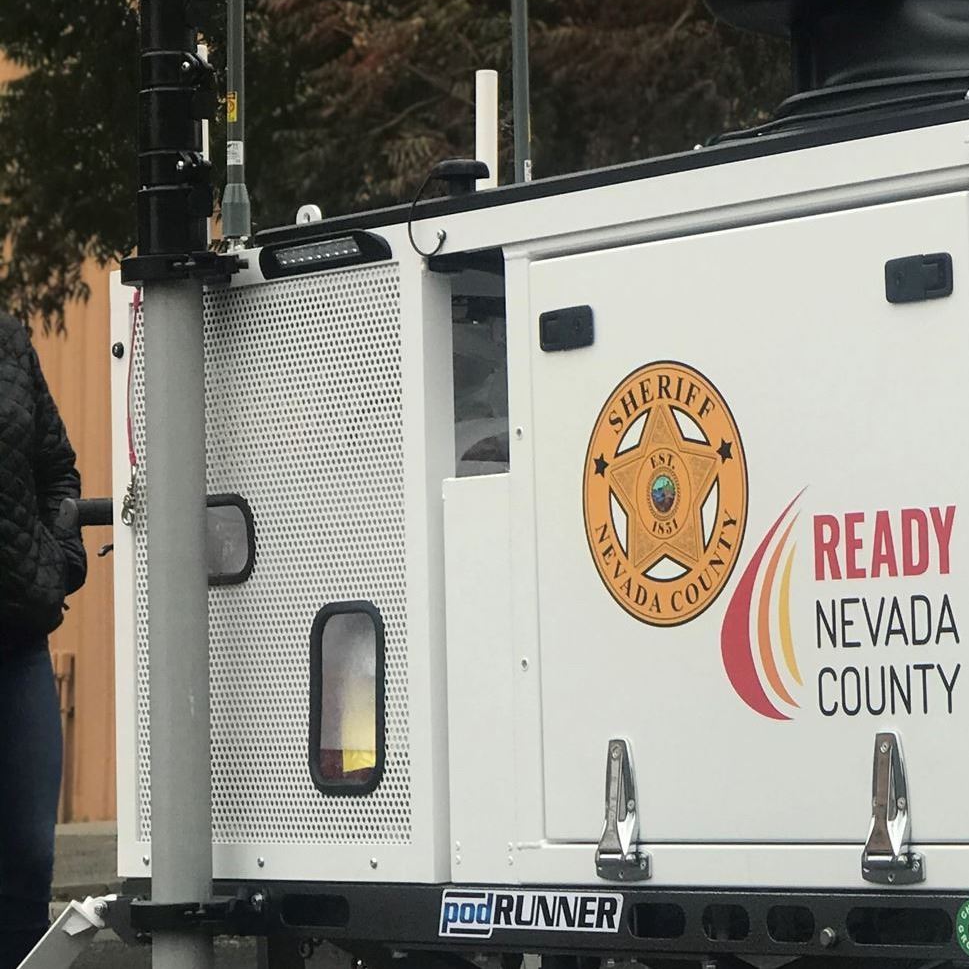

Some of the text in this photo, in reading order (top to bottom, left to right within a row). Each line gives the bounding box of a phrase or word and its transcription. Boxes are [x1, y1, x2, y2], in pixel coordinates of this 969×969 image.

[608, 374, 715, 434] SHERIFF
[650, 453, 675, 470] EST.
[652, 517, 679, 535] 1851
[813, 505, 957, 581] READY
[595, 508, 738, 614] NEVADA COUNTY
[815, 593, 961, 650] NEVADA
[817, 662, 962, 717] COUNTY
